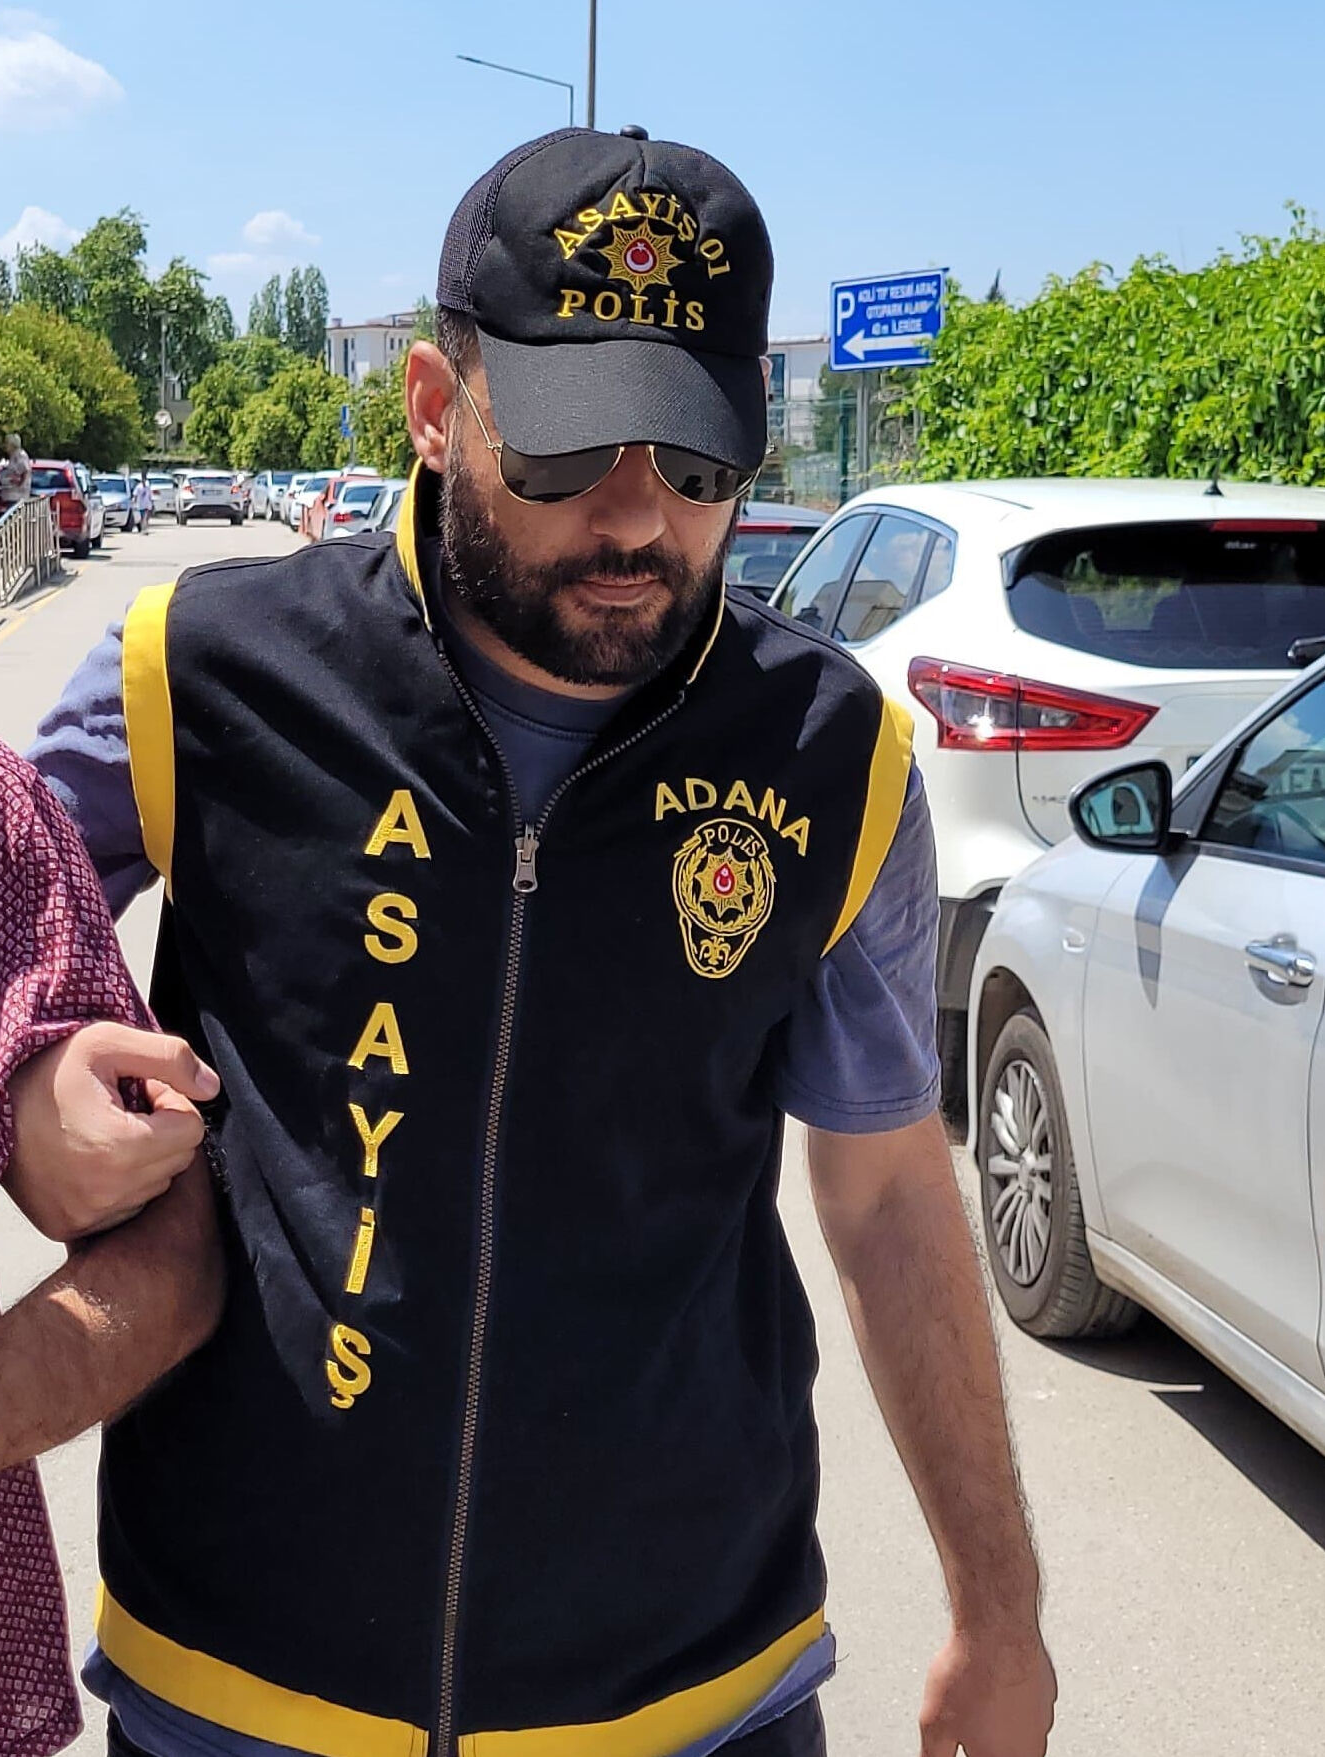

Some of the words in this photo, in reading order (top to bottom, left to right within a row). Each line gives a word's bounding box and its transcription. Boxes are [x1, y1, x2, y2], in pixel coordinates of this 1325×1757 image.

[553, 191, 697, 260] ASAYİŞ
[557, 289, 705, 331] POLİS
[655, 777, 810, 857] ADANA
[703, 824, 762, 857] POLİS
[325, 789, 431, 1411] ASAYİŞ
